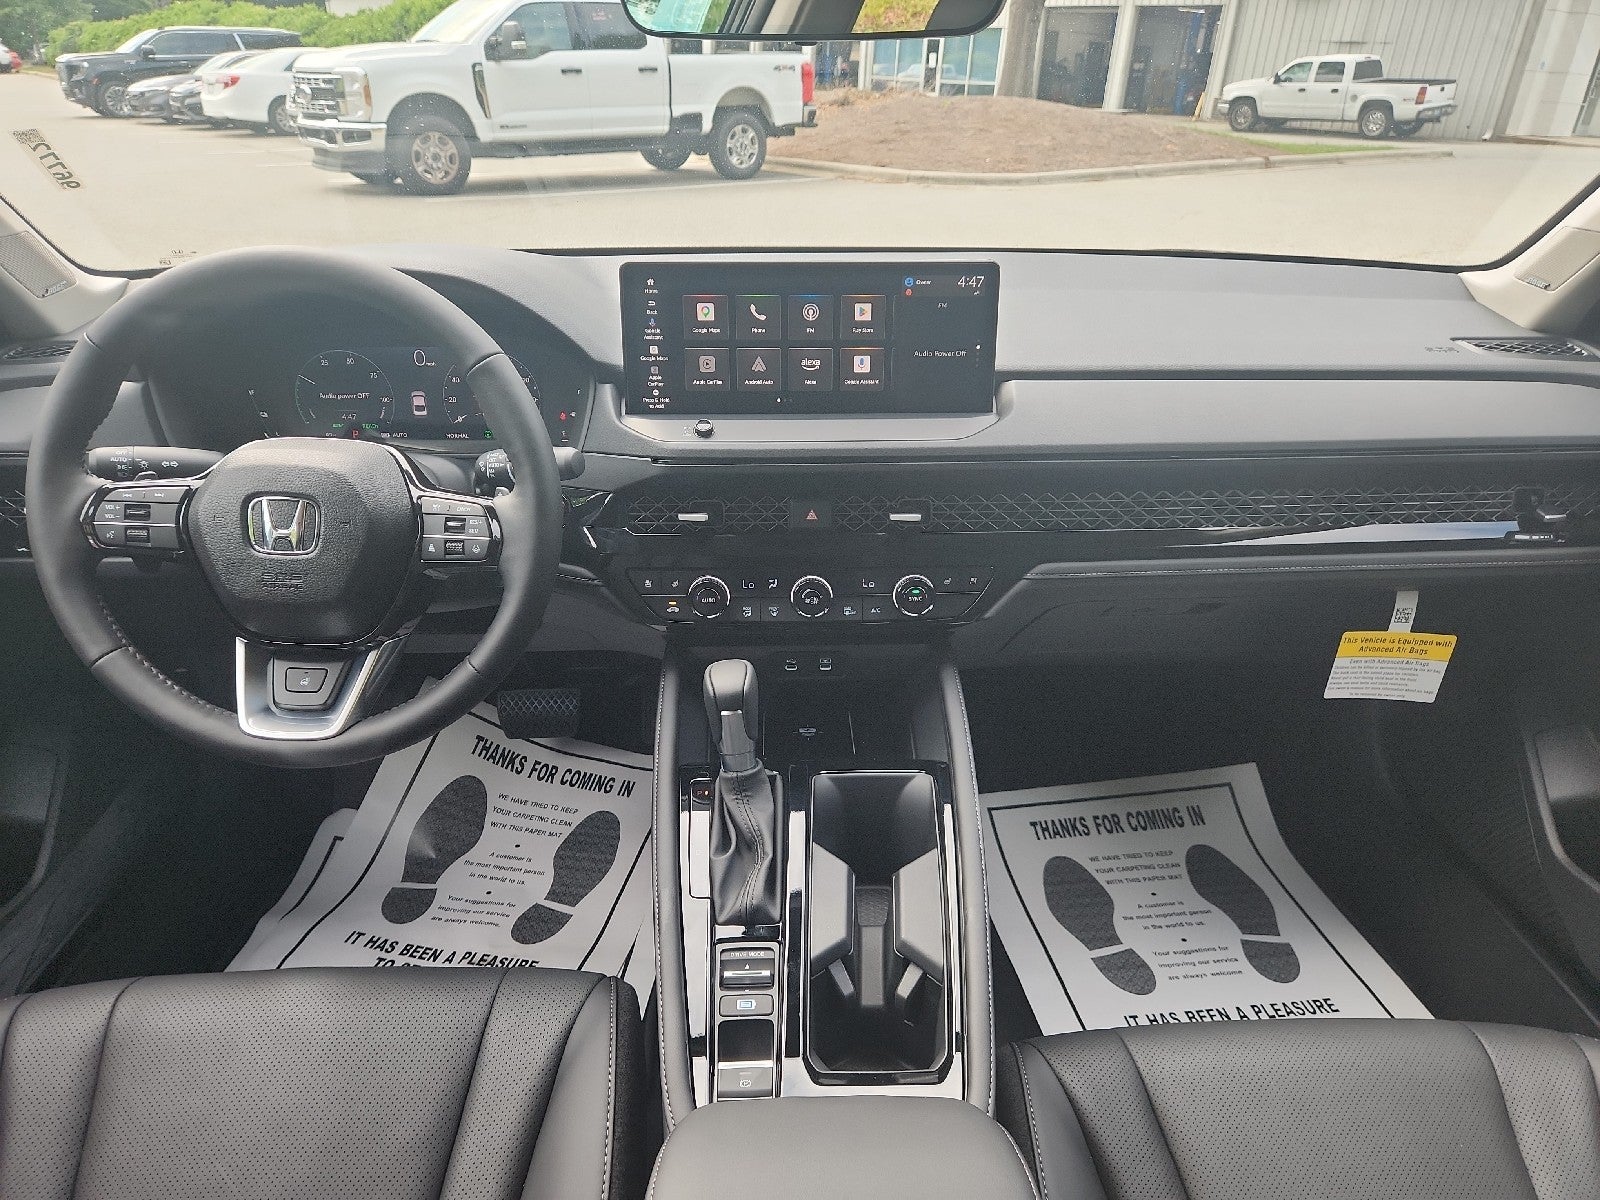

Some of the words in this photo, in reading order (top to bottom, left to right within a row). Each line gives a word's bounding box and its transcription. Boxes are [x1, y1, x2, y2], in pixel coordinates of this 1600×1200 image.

[958, 275, 985, 288] 4:47
[801, 358, 821, 366] alexa
[352, 430, 358, 439] P
[742, 579, 755, 589] Lo
[862, 578, 875, 588] Lo
[1360, 636, 1387, 644] Vehicle
[1397, 637, 1433, 646] Equipped
[1435, 640, 1453, 648] with
[1359, 645, 1394, 653] Advanced
[1409, 646, 1428, 656] Bags
[471, 734, 528, 775] THANKS
[527, 759, 559, 784] FOR
[560, 768, 616, 794] COMING
[617, 779, 636, 798] IN
[498, 792, 509, 800] WE
[510, 796, 529, 806] HAVE
[530, 801, 549, 809] TRIED
[560, 806, 579, 814] KEEP
[492, 805, 512, 817] YOUR
[512, 811, 550, 823] CARPETING
[550, 818, 573, 827] CLEAN
[490, 820, 508, 830] WITH
[509, 824, 524, 832] THIS
[524, 827, 547, 836] PAPER
[1029, 816, 1091, 841] THANKS
[1092, 813, 1125, 835] FOR
[1126, 806, 1185, 832] COMING
[1186, 804, 1206, 826] IN
[495, 852, 525, 862] customer
[492, 864, 523, 873] important
[522, 868, 546, 876] person
[489, 875, 508, 883] world
[447, 894, 464, 902] Your
[464, 898, 505, 906] suggestions
[437, 905, 472, 914] improving
[485, 910, 511, 918] service
[444, 917, 468, 925] always
[343, 930, 367, 945] IT
[363, 935, 399, 954] HAS
[398, 943, 445, 963] BEEN
[442, 950, 457, 965] A
[458, 951, 541, 968] PLEASURE
[1172, 946, 1217, 955] suggestions
[1123, 1014, 1139, 1027] IT
[1145, 1012, 1181, 1025] HAS
[1184, 1007, 1232, 1022] BEEN
[1235, 1006, 1250, 1020] A
[1250, 998, 1341, 1019] PLEASURE
